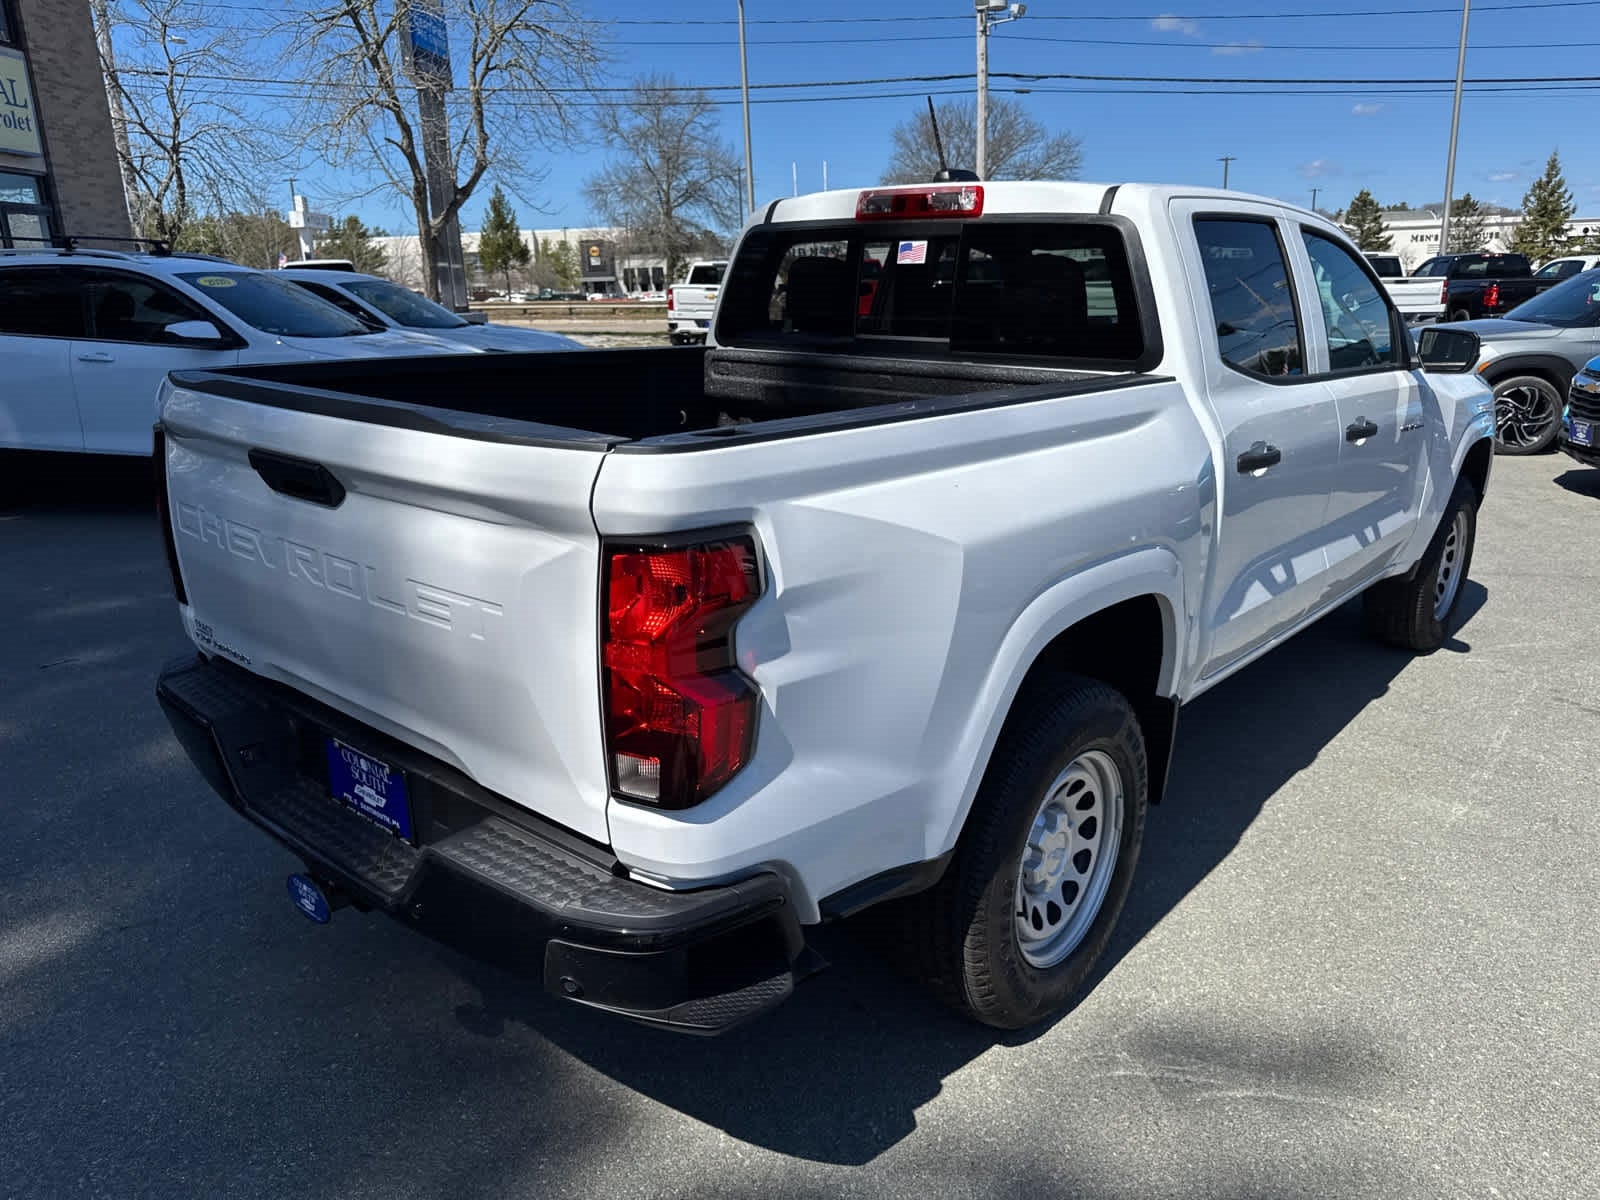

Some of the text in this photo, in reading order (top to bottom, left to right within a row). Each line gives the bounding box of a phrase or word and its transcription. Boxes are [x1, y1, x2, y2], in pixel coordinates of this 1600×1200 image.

[1410, 233, 1439, 243] MEN'S
[174, 500, 506, 642] CHEVROLET
[351, 765, 387, 794] SOUTH
